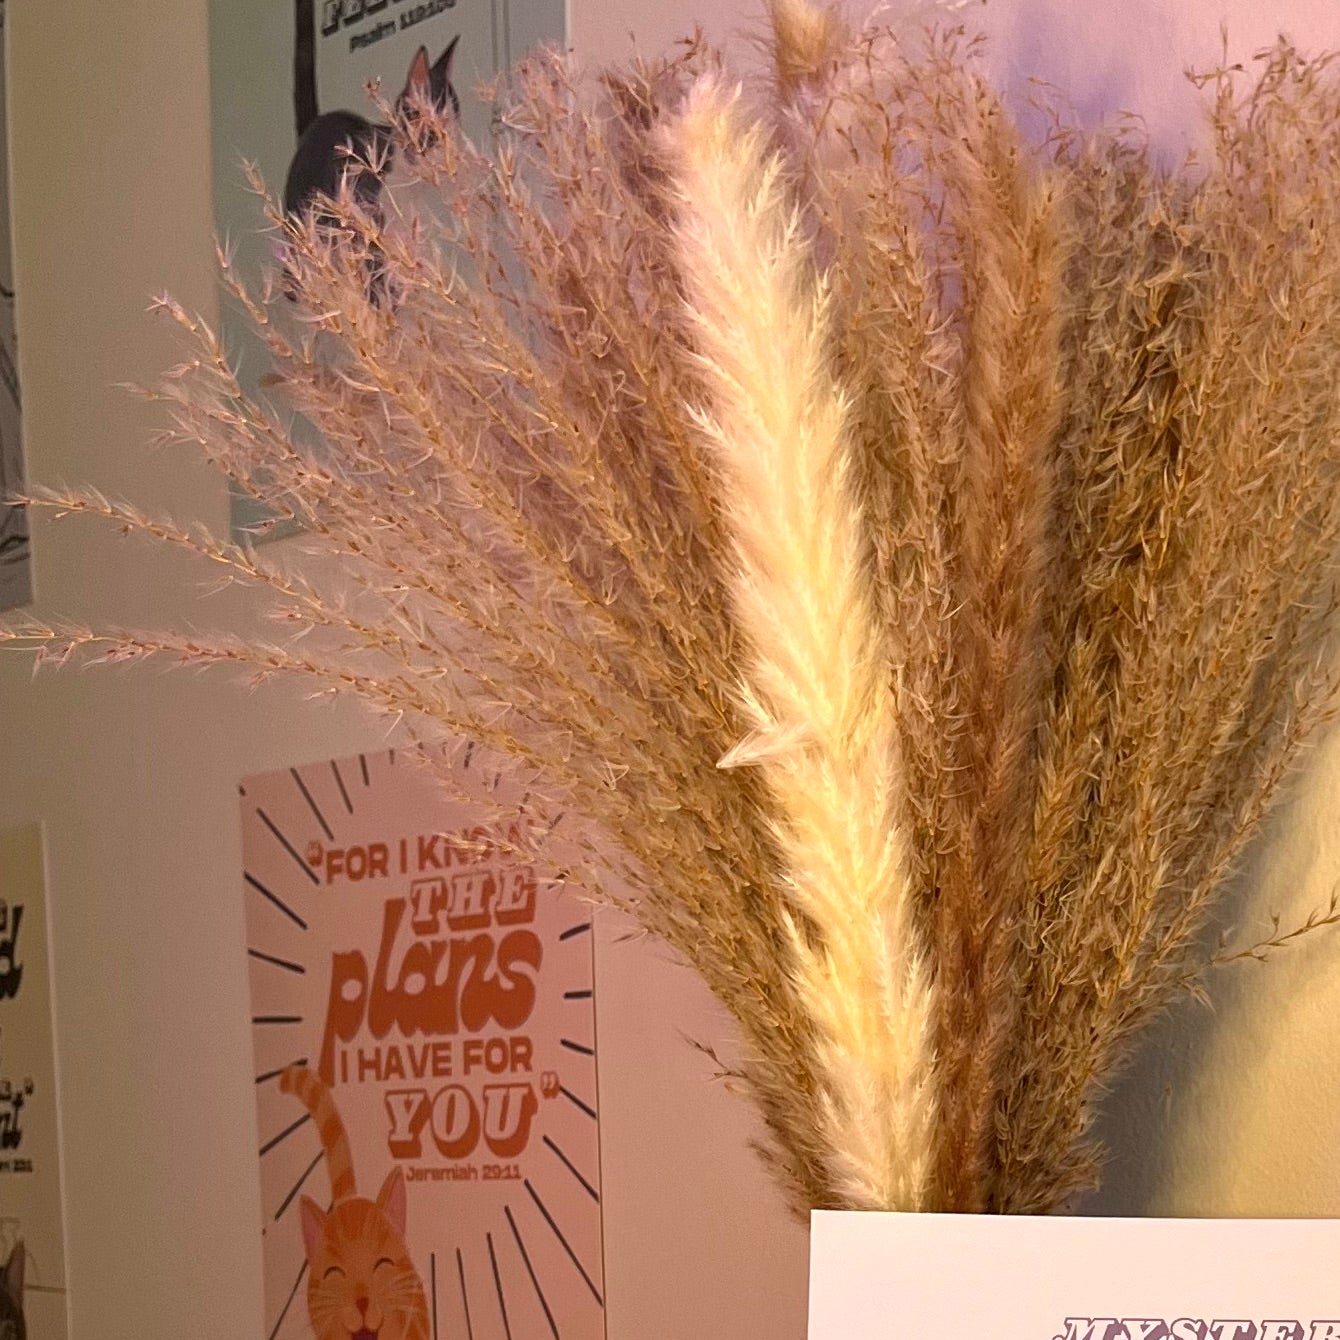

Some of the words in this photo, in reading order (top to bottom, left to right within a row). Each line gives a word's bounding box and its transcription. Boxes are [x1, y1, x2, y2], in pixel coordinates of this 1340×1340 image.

[399, 838, 408, 874] I
[410, 866, 537, 937] THE
[319, 897, 543, 1089] plans
[340, 1049, 349, 1084] I
[357, 1041, 453, 1083] HAVE
[463, 1035, 534, 1076] FOR
[405, 1164, 478, 1182] Jeremiah
